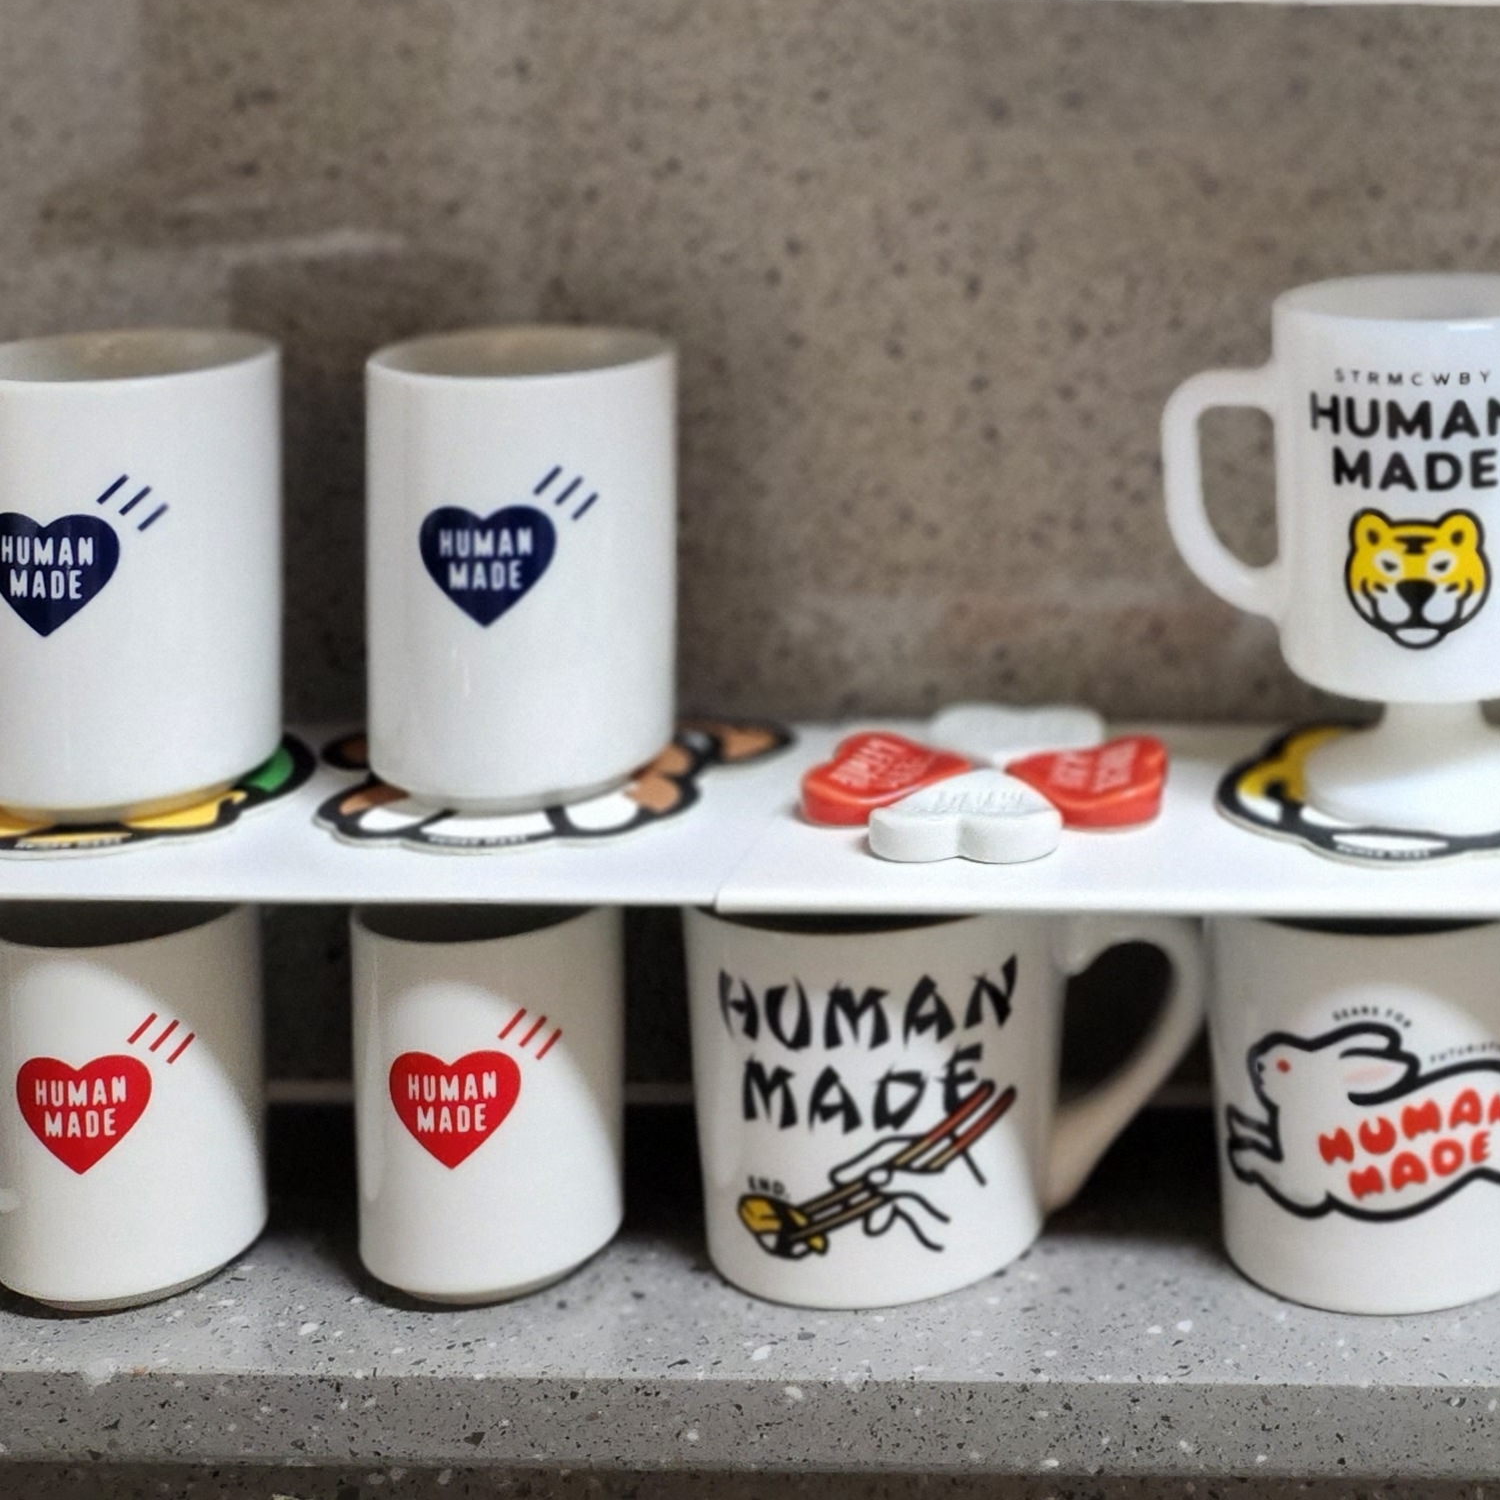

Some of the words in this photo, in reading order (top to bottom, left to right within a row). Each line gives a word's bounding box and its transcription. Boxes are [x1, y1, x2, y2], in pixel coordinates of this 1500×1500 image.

[1334, 367, 1492, 386] STRMCWBY
[1332, 446, 1499, 492] MADE
[2, 534, 94, 567] HUMAN
[439, 527, 533, 558] HUMAN
[10, 568, 83, 600] MADE
[449, 560, 522, 591] MADE
[719, 953, 1017, 1051] HUMAN
[35, 1075, 127, 1107] HUMAN
[407, 1071, 498, 1101] HUMAN
[743, 1042, 984, 1136] MADE
[44, 1107, 117, 1138] MADE
[416, 1102, 486, 1134] MADE
[1347, 1130, 1492, 1201] MADE
